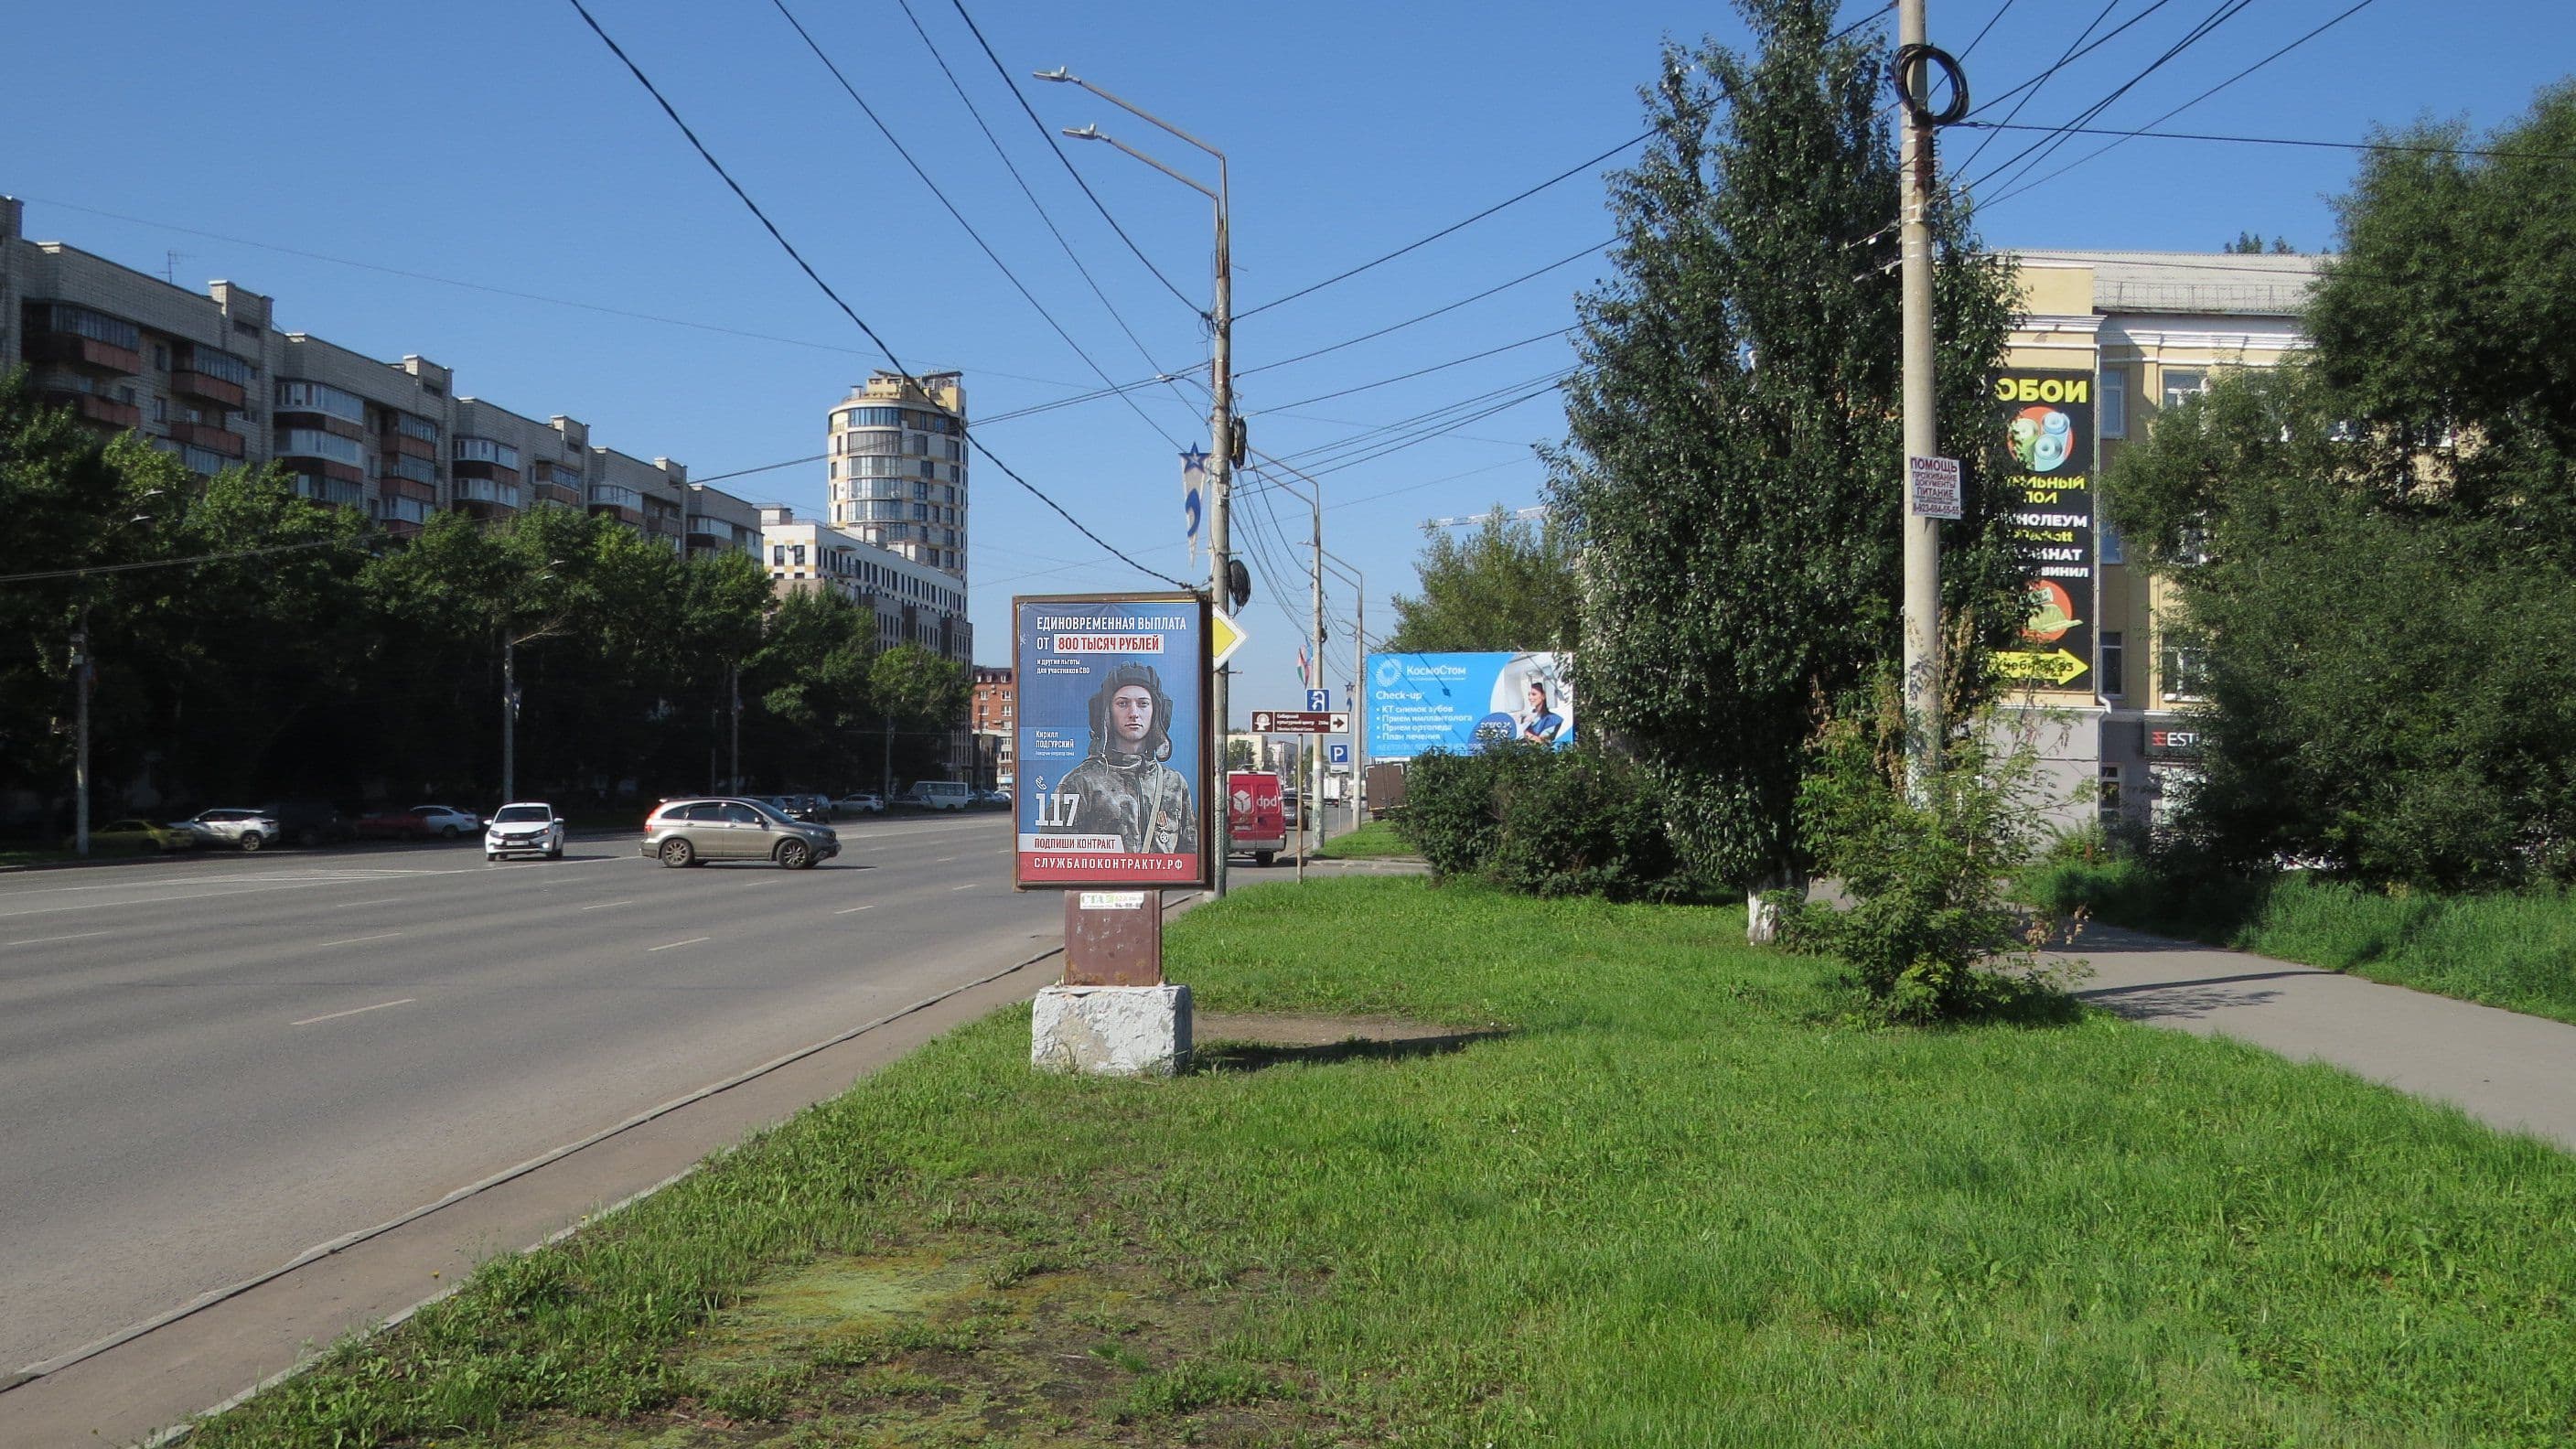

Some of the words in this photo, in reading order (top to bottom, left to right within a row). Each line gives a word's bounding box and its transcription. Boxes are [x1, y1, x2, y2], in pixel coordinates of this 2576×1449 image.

[1996, 378, 2087, 403] ОБОИ
[1910, 458, 1958, 474] ПОМОЩЬ
[1913, 471, 1957, 481] ПРОЖИВАНИЕ
[1916, 478, 1955, 488] ДОКУМЕНТЫ
[1916, 487, 1954, 498] ПИТАНИЕ
[2003, 513, 2088, 527] НОЛЕУМ
[1036, 617, 1135, 631] ЕДИНОВРЕМЕННАЯ
[1138, 617, 1186, 630] ВЫПЛАТА
[1036, 637, 1049, 650] ОТ
[1058, 637, 1079, 650] 800
[1081, 637, 1116, 650] ТЫСЯЧ
[1119, 635, 1159, 650] РУБЛЕЙ
[1406, 665, 1466, 676] КосмоСтом
[1428, 704, 1454, 714] зубов
[1411, 714, 1473, 723] имплантолога
[1036, 731, 1058, 739] Кирилл
[1036, 739, 1074, 748] ПОДГУРСКИЙ
[1334, 746, 1344, 761] P
[1256, 795, 1277, 810] dpd
[1035, 793, 1080, 827] 117
[1034, 838, 1075, 850] ПОДПИШИ
[1077, 838, 1116, 850] КОНТРАКТ
[1034, 857, 1184, 870] СЛУЖБАПОКОНТРАКТУ.РФ
